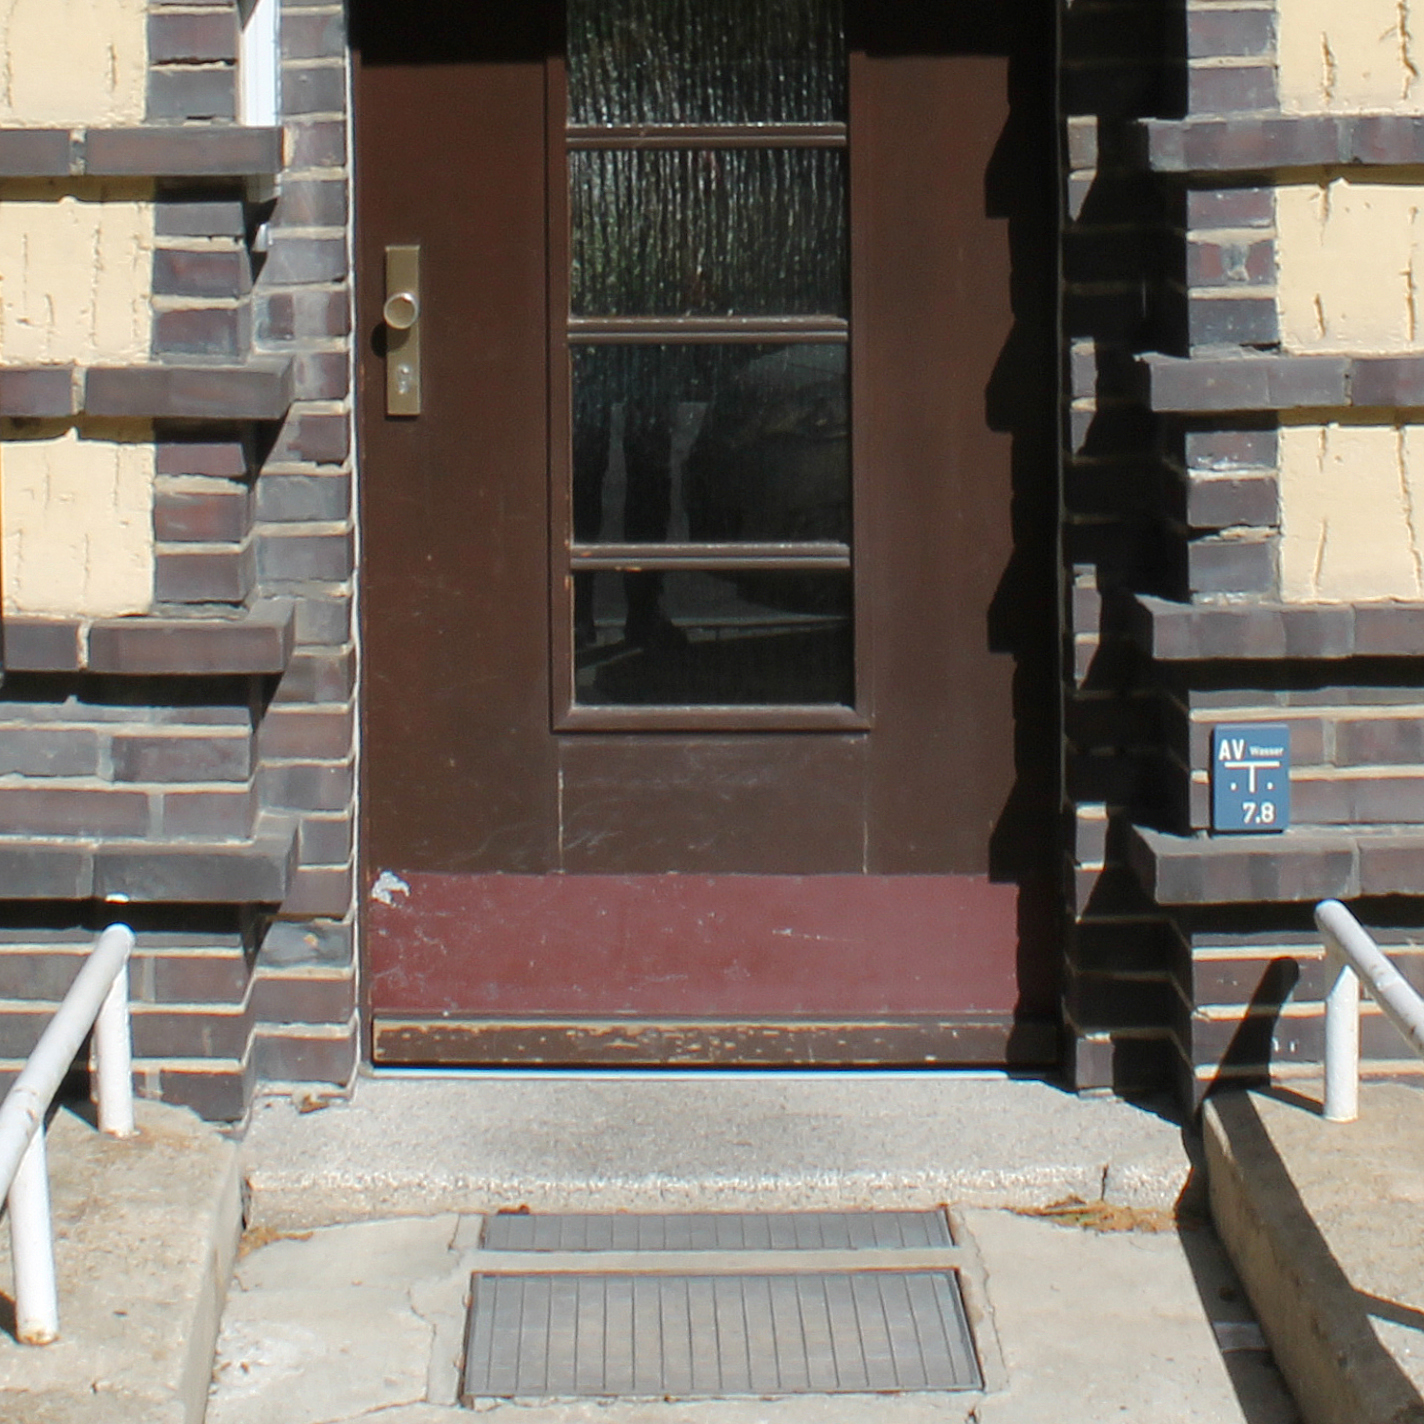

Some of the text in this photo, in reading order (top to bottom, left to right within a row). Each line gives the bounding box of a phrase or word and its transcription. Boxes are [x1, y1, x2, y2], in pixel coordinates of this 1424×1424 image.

[1218, 739, 1285, 761] AV Wasser
[1242, 802, 1275, 824] 7.8
